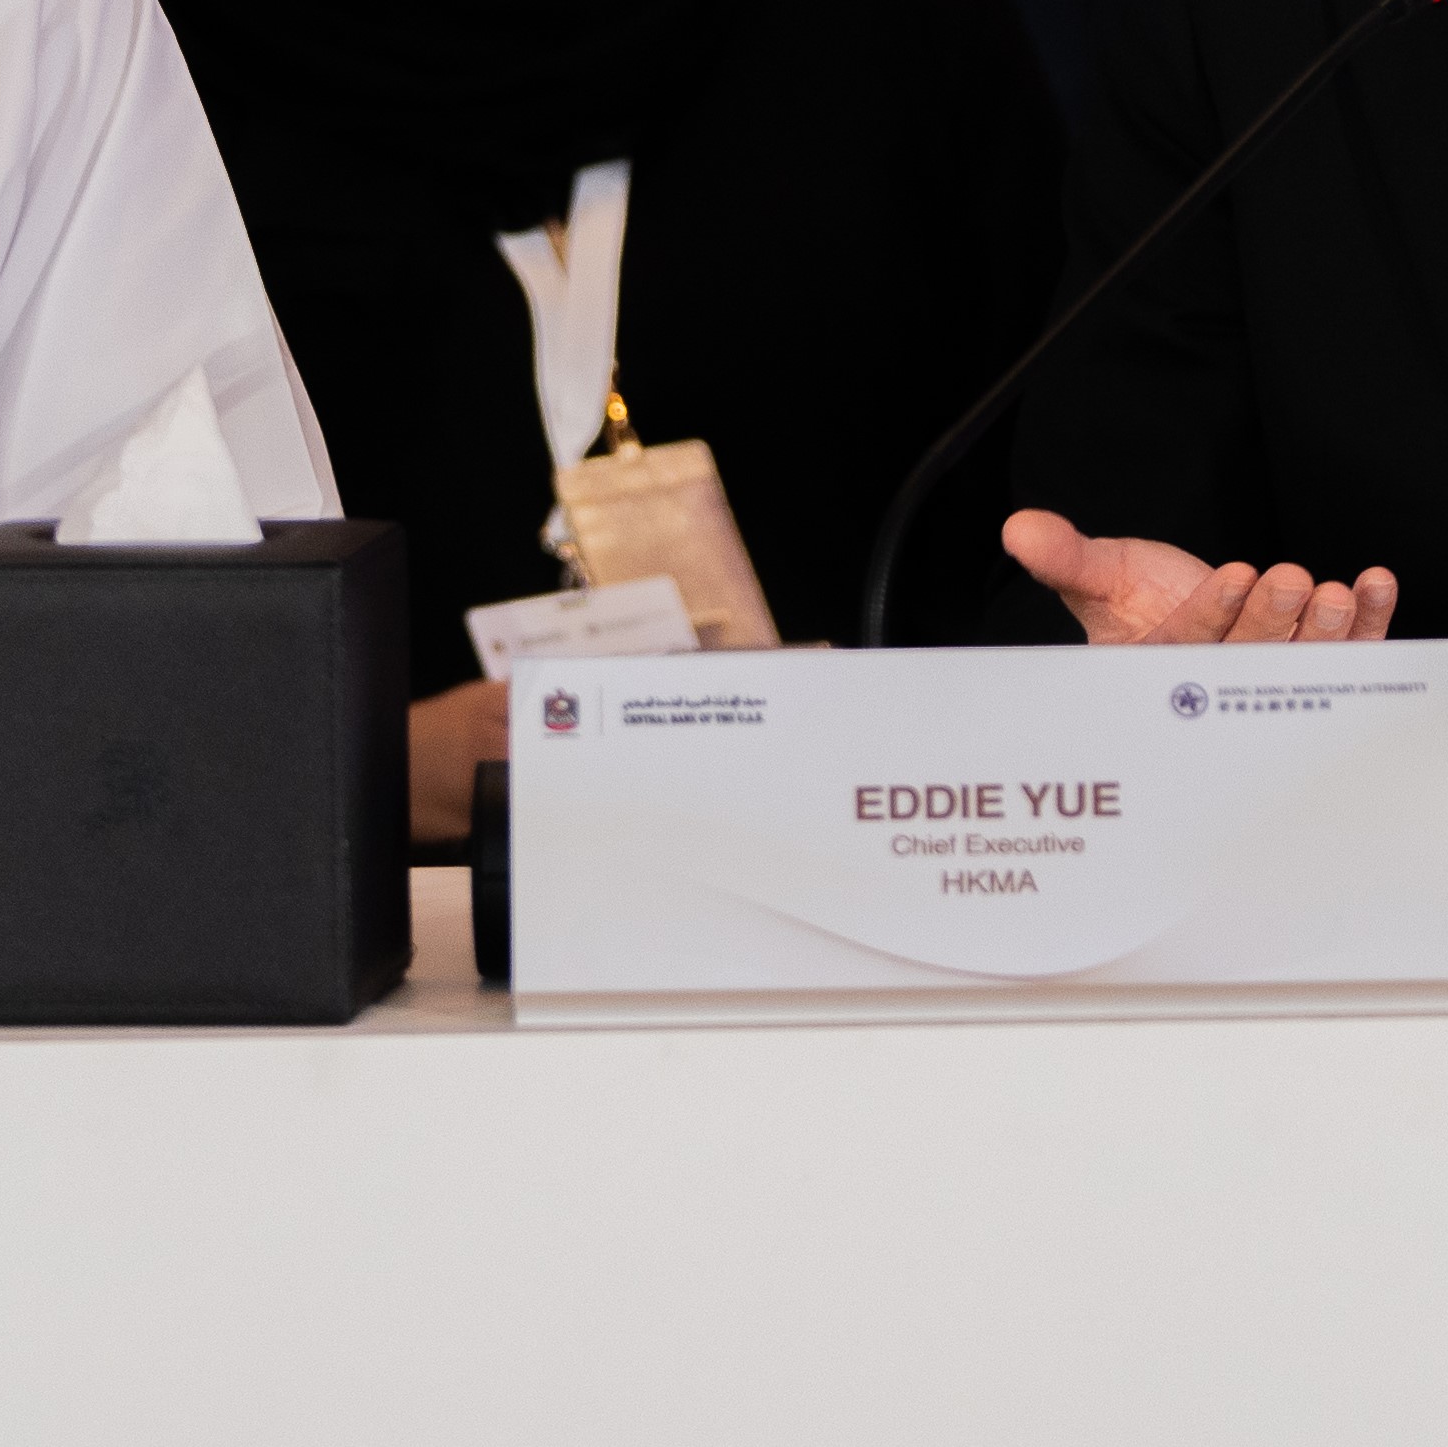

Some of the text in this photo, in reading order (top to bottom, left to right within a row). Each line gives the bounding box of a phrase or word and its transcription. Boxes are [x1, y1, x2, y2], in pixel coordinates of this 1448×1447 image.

[855, 781, 1122, 820] EDDIE YUE
[890, 832, 1086, 856] Chief Executive
[940, 868, 1039, 894] HKMA
